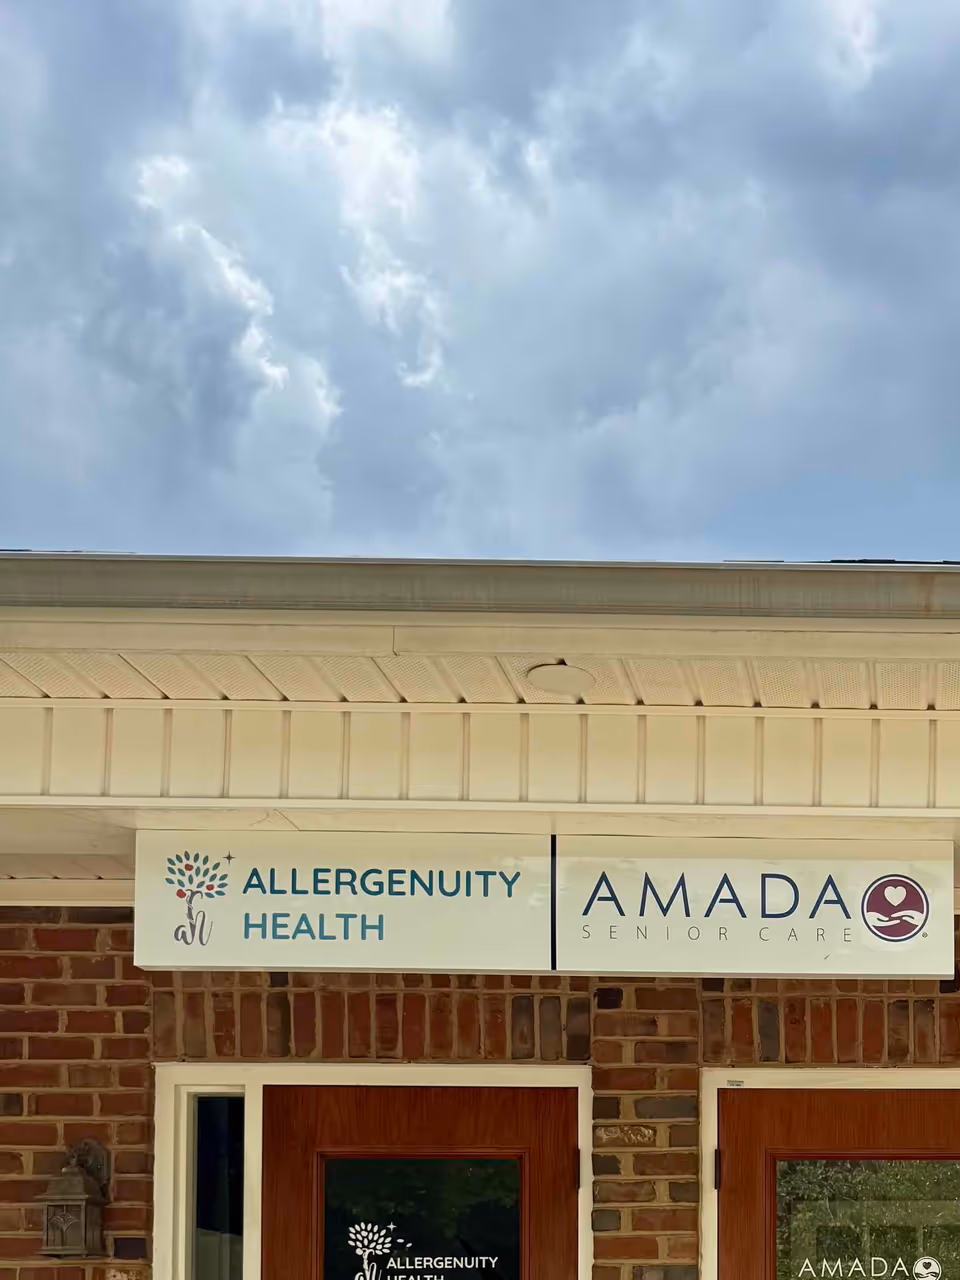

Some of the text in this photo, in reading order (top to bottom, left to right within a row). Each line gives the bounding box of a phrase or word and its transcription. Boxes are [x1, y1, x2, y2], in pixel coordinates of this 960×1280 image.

[242, 867, 521, 898] ALLERGENUITY
[581, 870, 852, 919] AMADA
[243, 912, 384, 941] HEALTH
[581, 924, 852, 943] SENIOR CARE
[386, 1256, 499, 1269] ALLERGENUITY
[798, 1257, 910, 1278] AMADA
